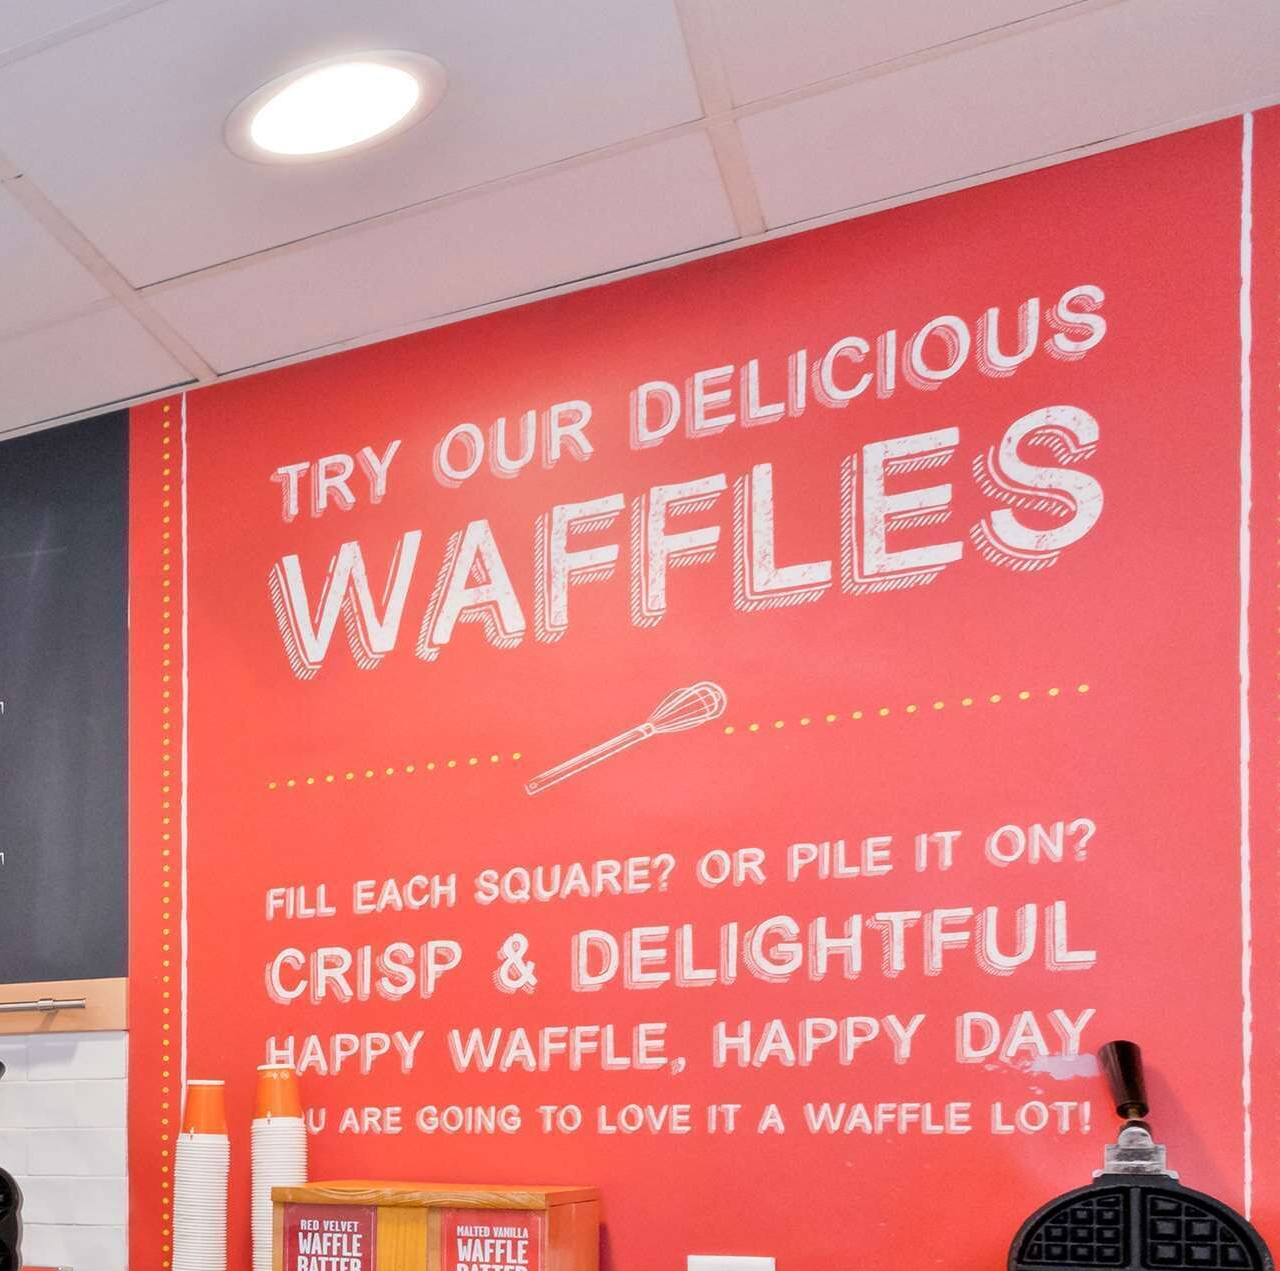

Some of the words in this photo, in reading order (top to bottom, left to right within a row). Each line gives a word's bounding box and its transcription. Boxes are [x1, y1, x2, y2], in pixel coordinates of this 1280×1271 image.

[270, 439, 401, 522] TRY
[433, 399, 593, 487] OUR
[629, 283, 1108, 448] DELICIOUS
[268, 404, 1105, 681] WAFFLES
[265, 884, 336, 921] FILL
[353, 873, 456, 915] EACH
[474, 853, 676, 905] SQUARE?
[696, 847, 766, 889] OR
[787, 835, 893, 882] PILE
[915, 830, 962, 873] IT
[985, 817, 1097, 868] ON?
[265, 939, 463, 1005] CRISP
[492, 932, 538, 995] &
[571, 900, 1097, 992] DELIGHTFUL
[266, 1029, 424, 1075] HAPPY
[448, 1022, 687, 1076] WAFFLE,
[713, 1013, 926, 1069] HAPPY
[956, 1007, 1097, 1066] DAY
[338, 1103, 402, 1134] ARE
[420, 1104, 522, 1134] GOING
[536, 1103, 583, 1134] TO
[597, 1103, 691, 1134] LOVE
[707, 1103, 741, 1134] IT
[756, 1103, 785, 1134] A
[803, 1102, 972, 1135] WAFFLE
[991, 1101, 1092, 1135] LOT!
[298, 1231, 363, 1257] WAFFLE
[300, 1219, 320, 1231] RED
[323, 1220, 359, 1232] VELVET
[457, 1225, 490, 1237] MALTED
[493, 1226, 529, 1239] VANILLA
[457, 1238, 529, 1264] WAFFLE
